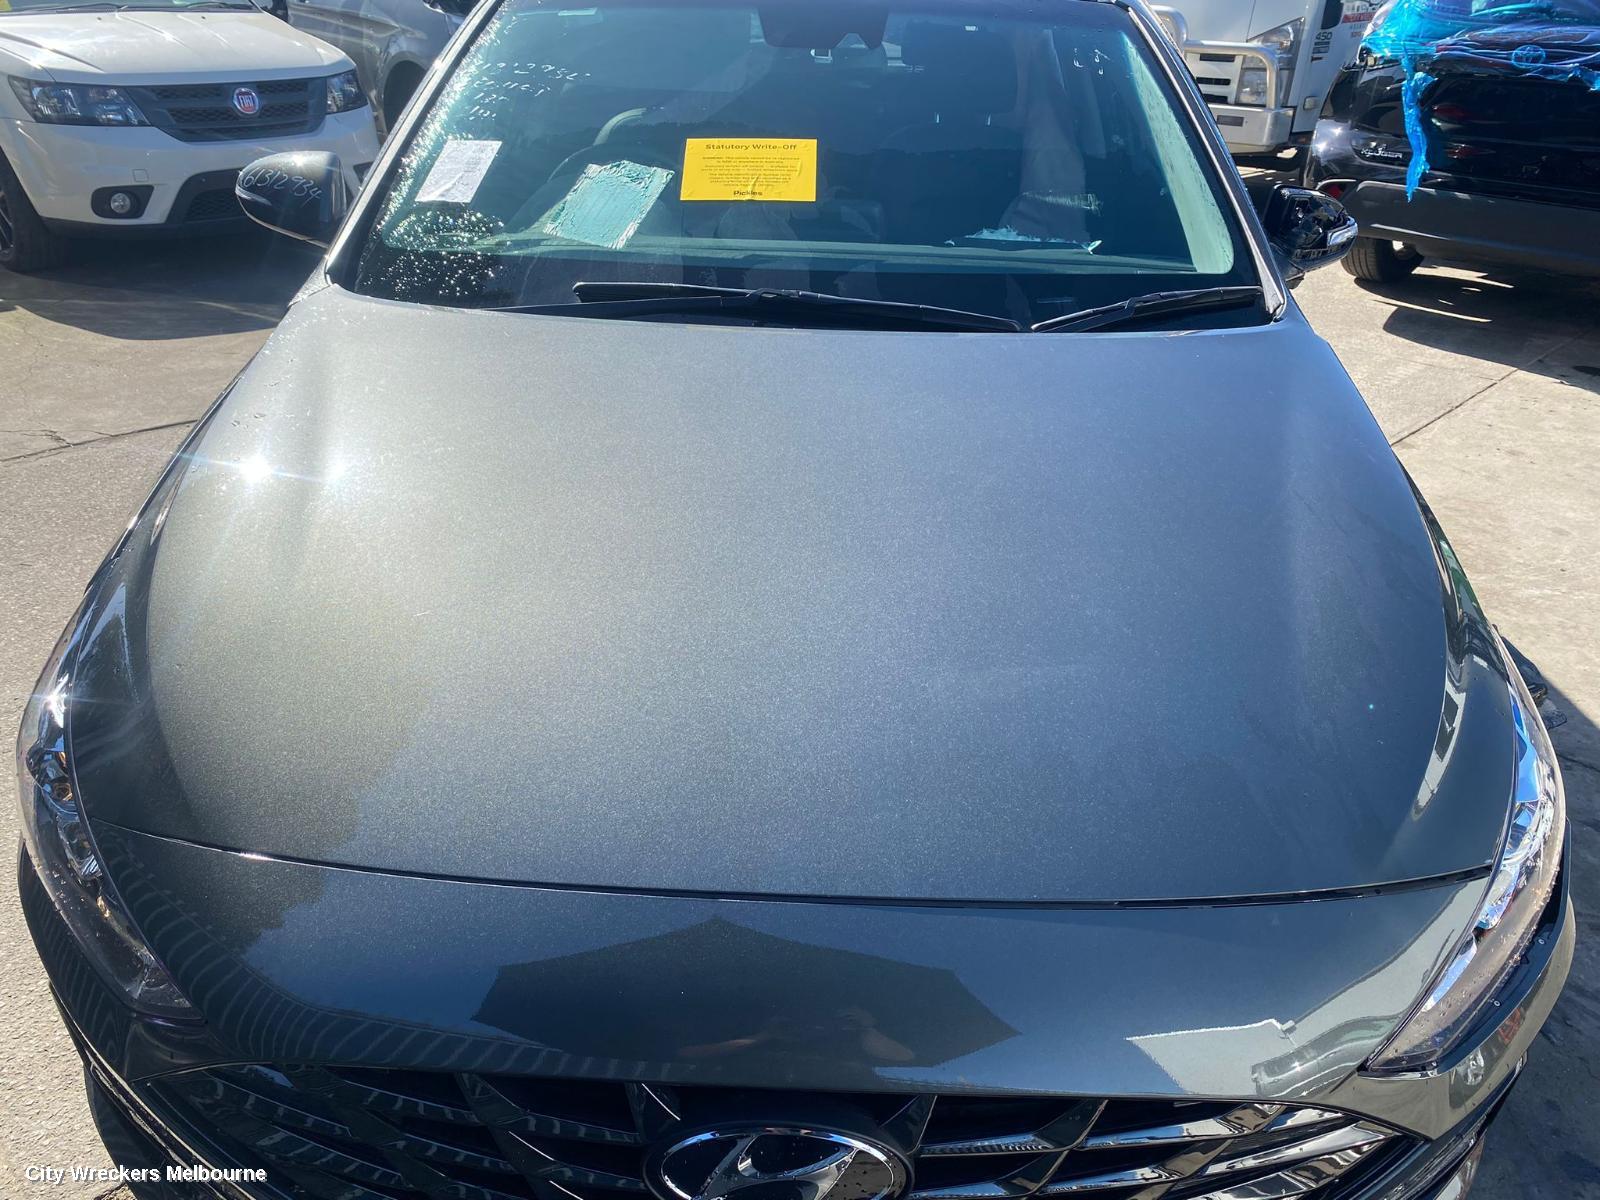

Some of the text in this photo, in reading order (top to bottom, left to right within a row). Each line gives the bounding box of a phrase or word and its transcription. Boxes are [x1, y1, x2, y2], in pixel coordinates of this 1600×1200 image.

[1315, 31, 1333, 41] 450
[238, 94, 254, 108] FIAT
[705, 143, 750, 151] Statutory
